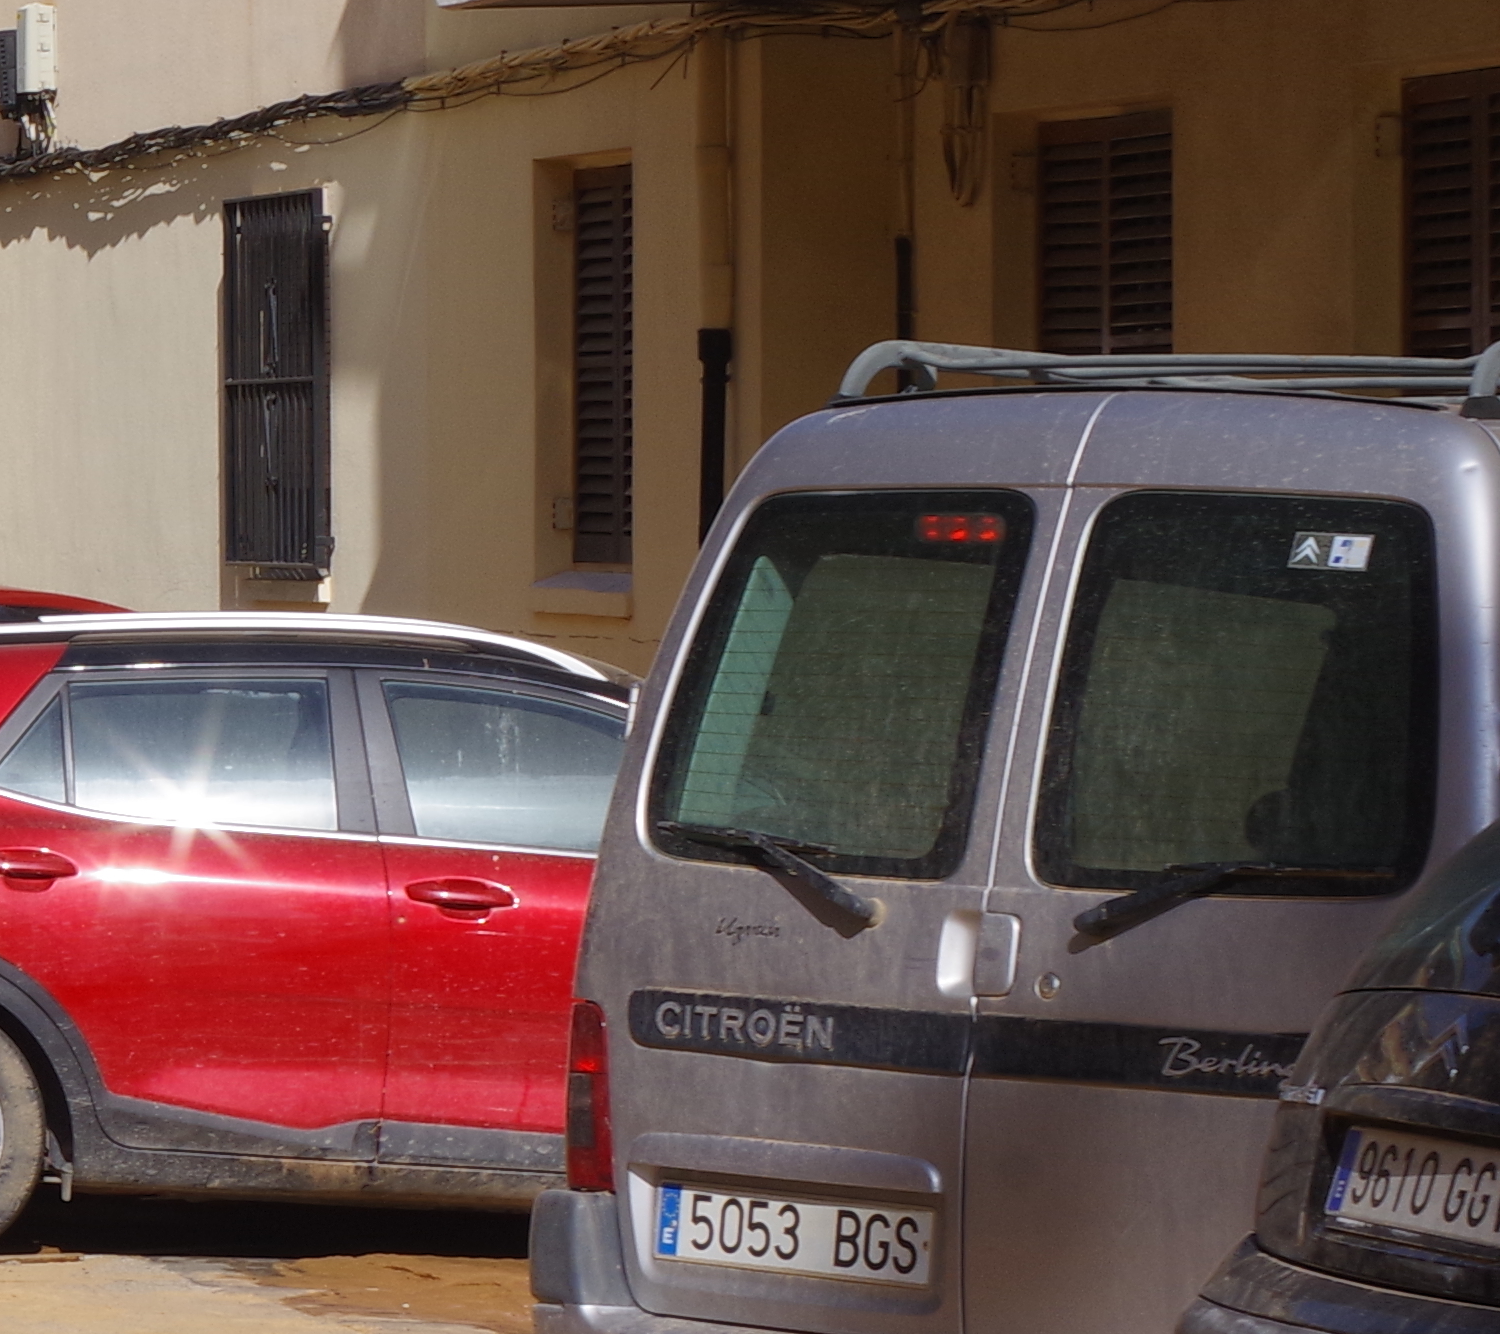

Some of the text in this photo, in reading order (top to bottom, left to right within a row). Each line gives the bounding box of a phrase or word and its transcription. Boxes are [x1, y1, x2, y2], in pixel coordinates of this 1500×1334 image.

[655, 1001, 835, 1051] CITROËN
[1158, 1036, 1298, 1079] Berlin
[1352, 1141, 1440, 1216] 9610
[1444, 1157, 1500, 1232] GG
[690, 1194, 800, 1261] 5053
[833, 1209, 919, 1275] BGS
